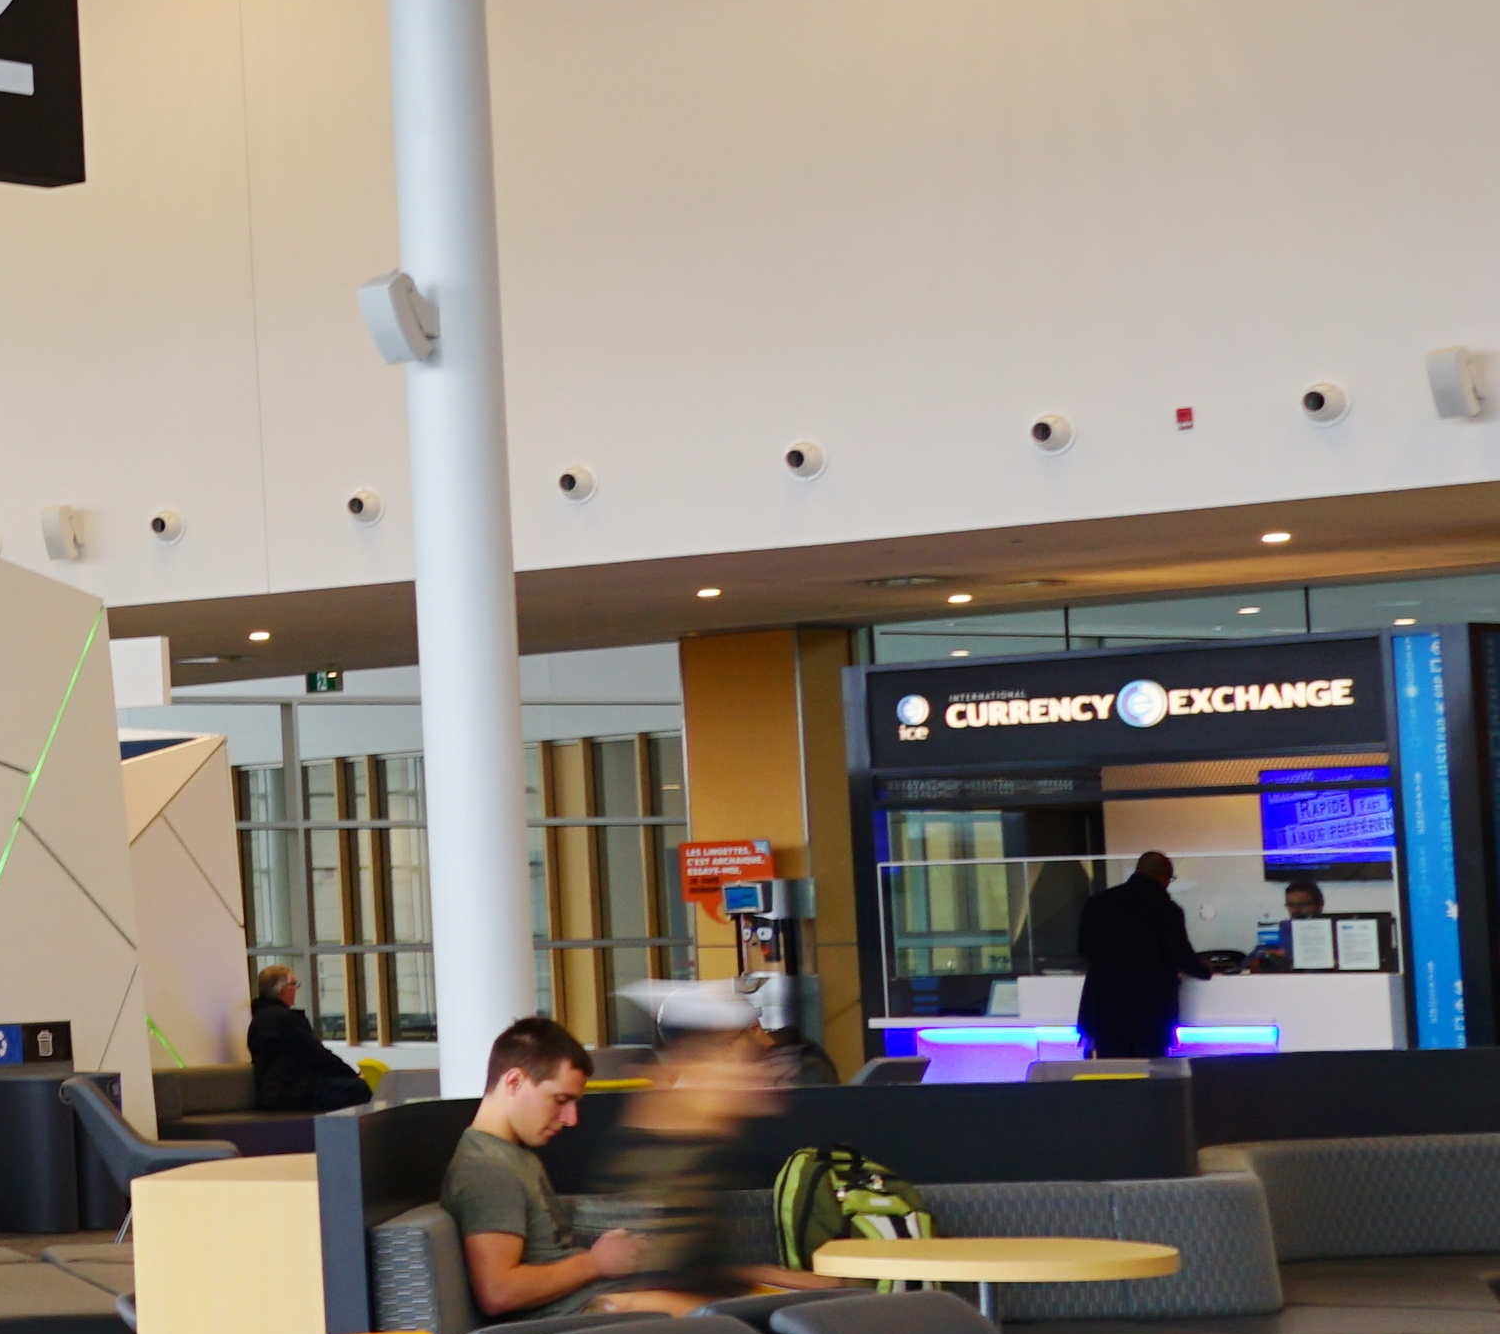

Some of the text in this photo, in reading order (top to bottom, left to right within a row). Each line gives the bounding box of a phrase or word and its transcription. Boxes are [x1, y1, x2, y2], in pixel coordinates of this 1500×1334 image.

[944, 678, 1355, 729] CURRENCY EXCHANGE
[948, 689, 1028, 703] INTERNATIONAL
[898, 723, 930, 742] ice
[1299, 799, 1349, 818] RAPIDE
